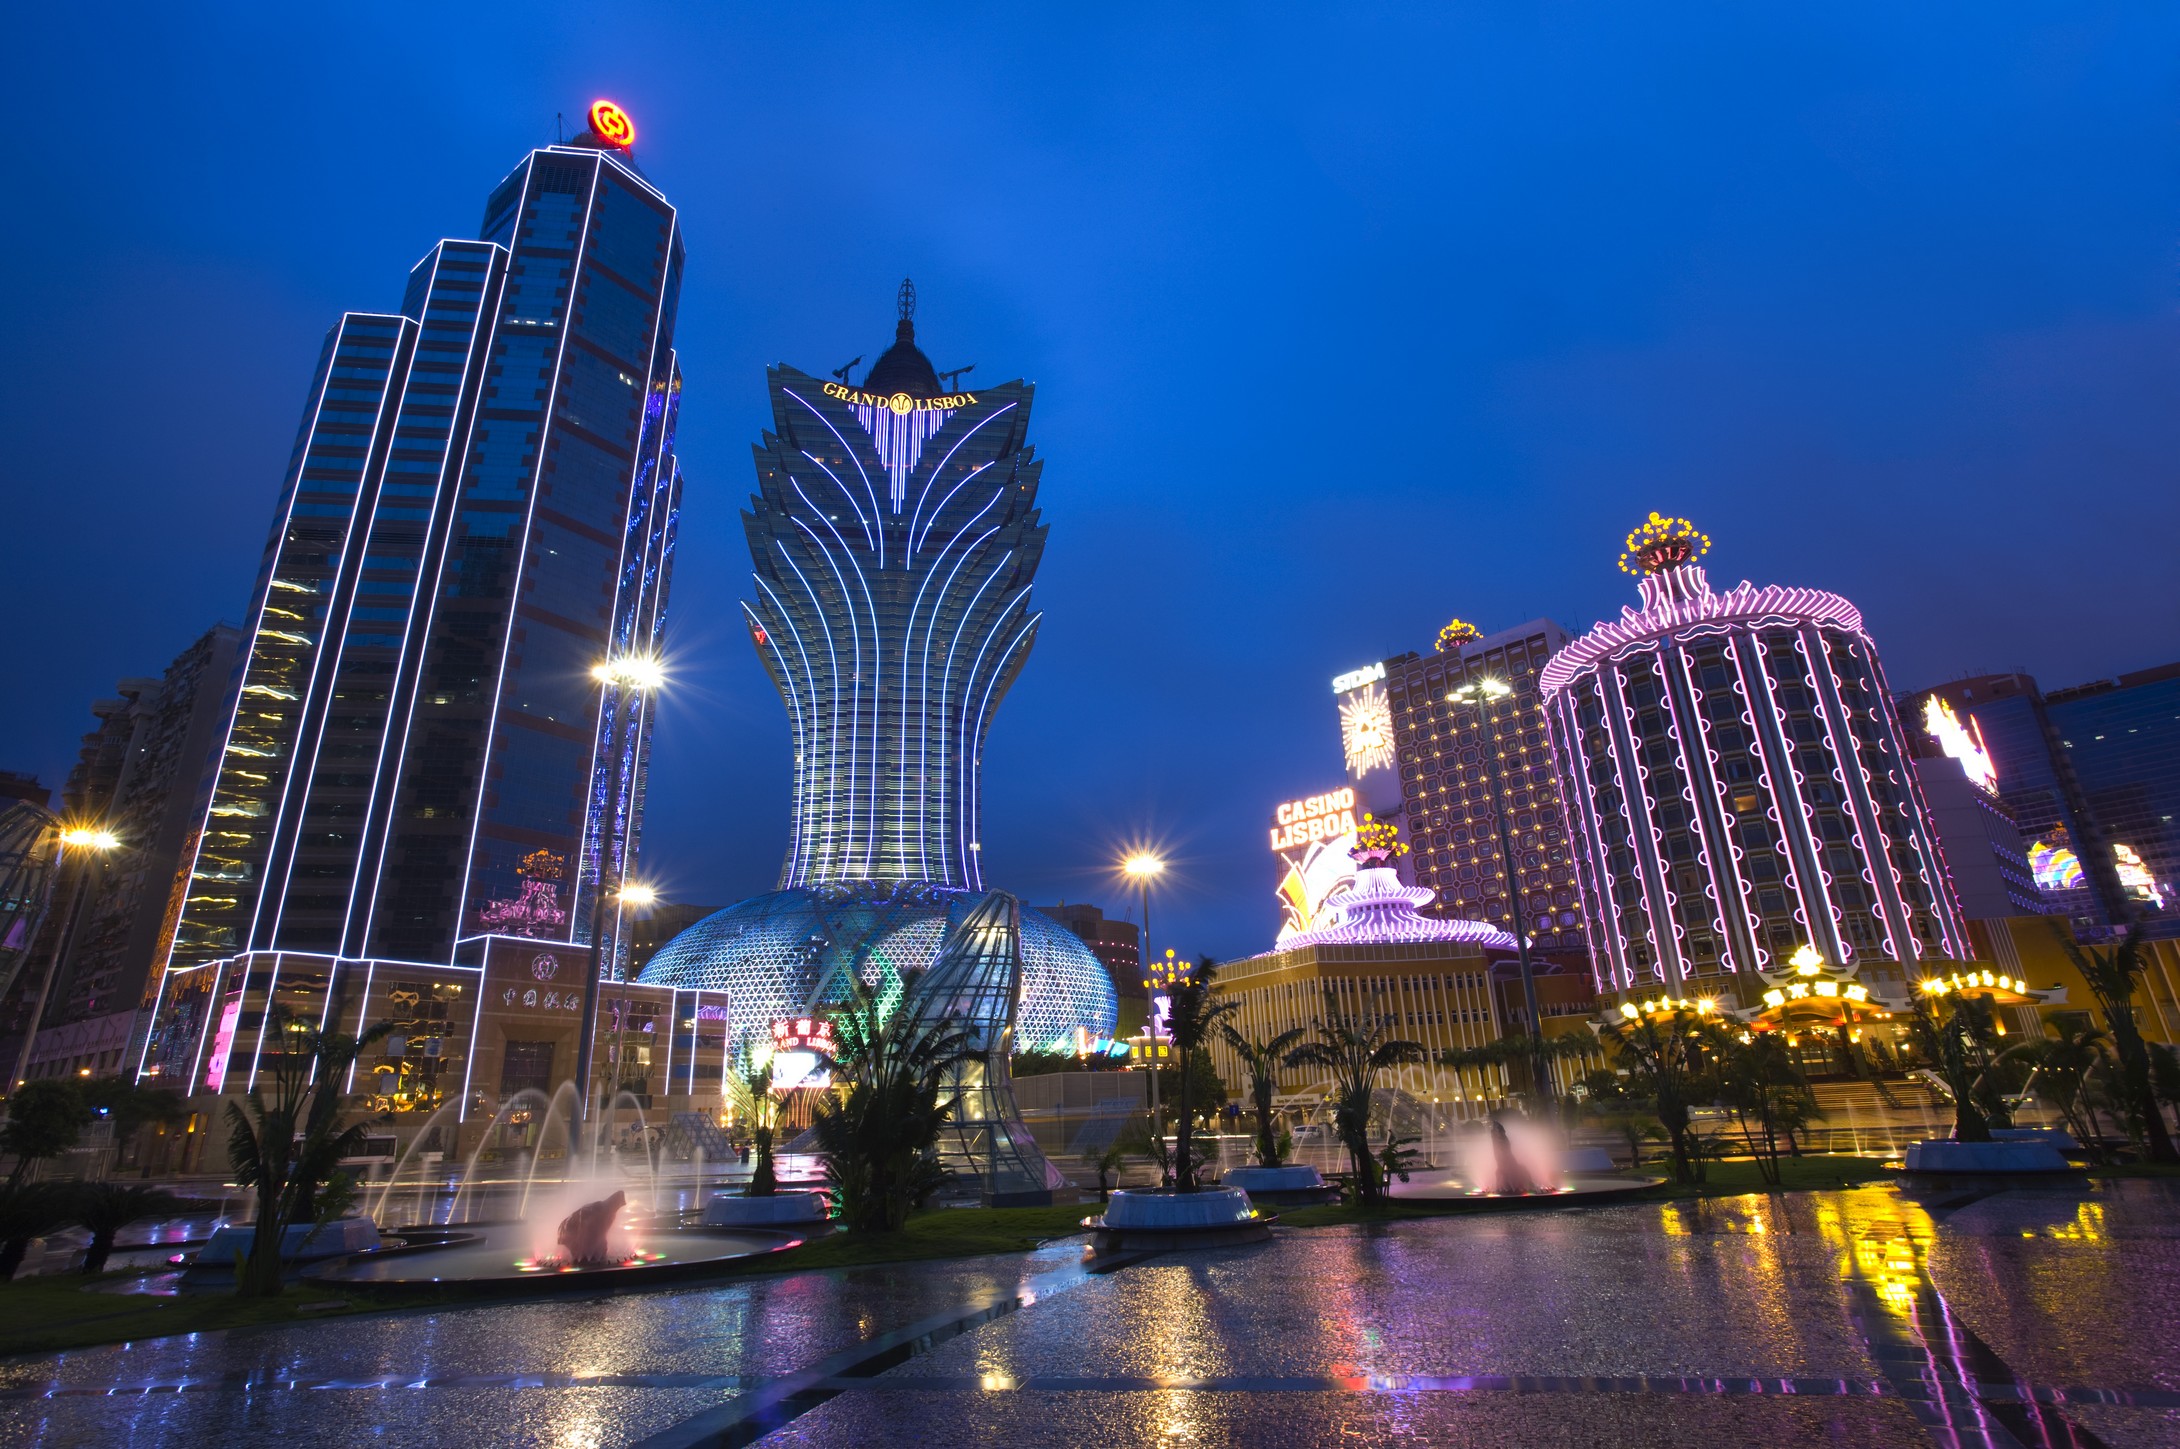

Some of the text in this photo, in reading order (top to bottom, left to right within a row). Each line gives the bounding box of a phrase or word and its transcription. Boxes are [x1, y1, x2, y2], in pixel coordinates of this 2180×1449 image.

[823, 382, 978, 411] GRAND LISBOA
[1276, 787, 1355, 826] CASINO
[1270, 809, 1358, 851] LISBOA
[769, 1036, 838, 1053] RAND LISBOA
